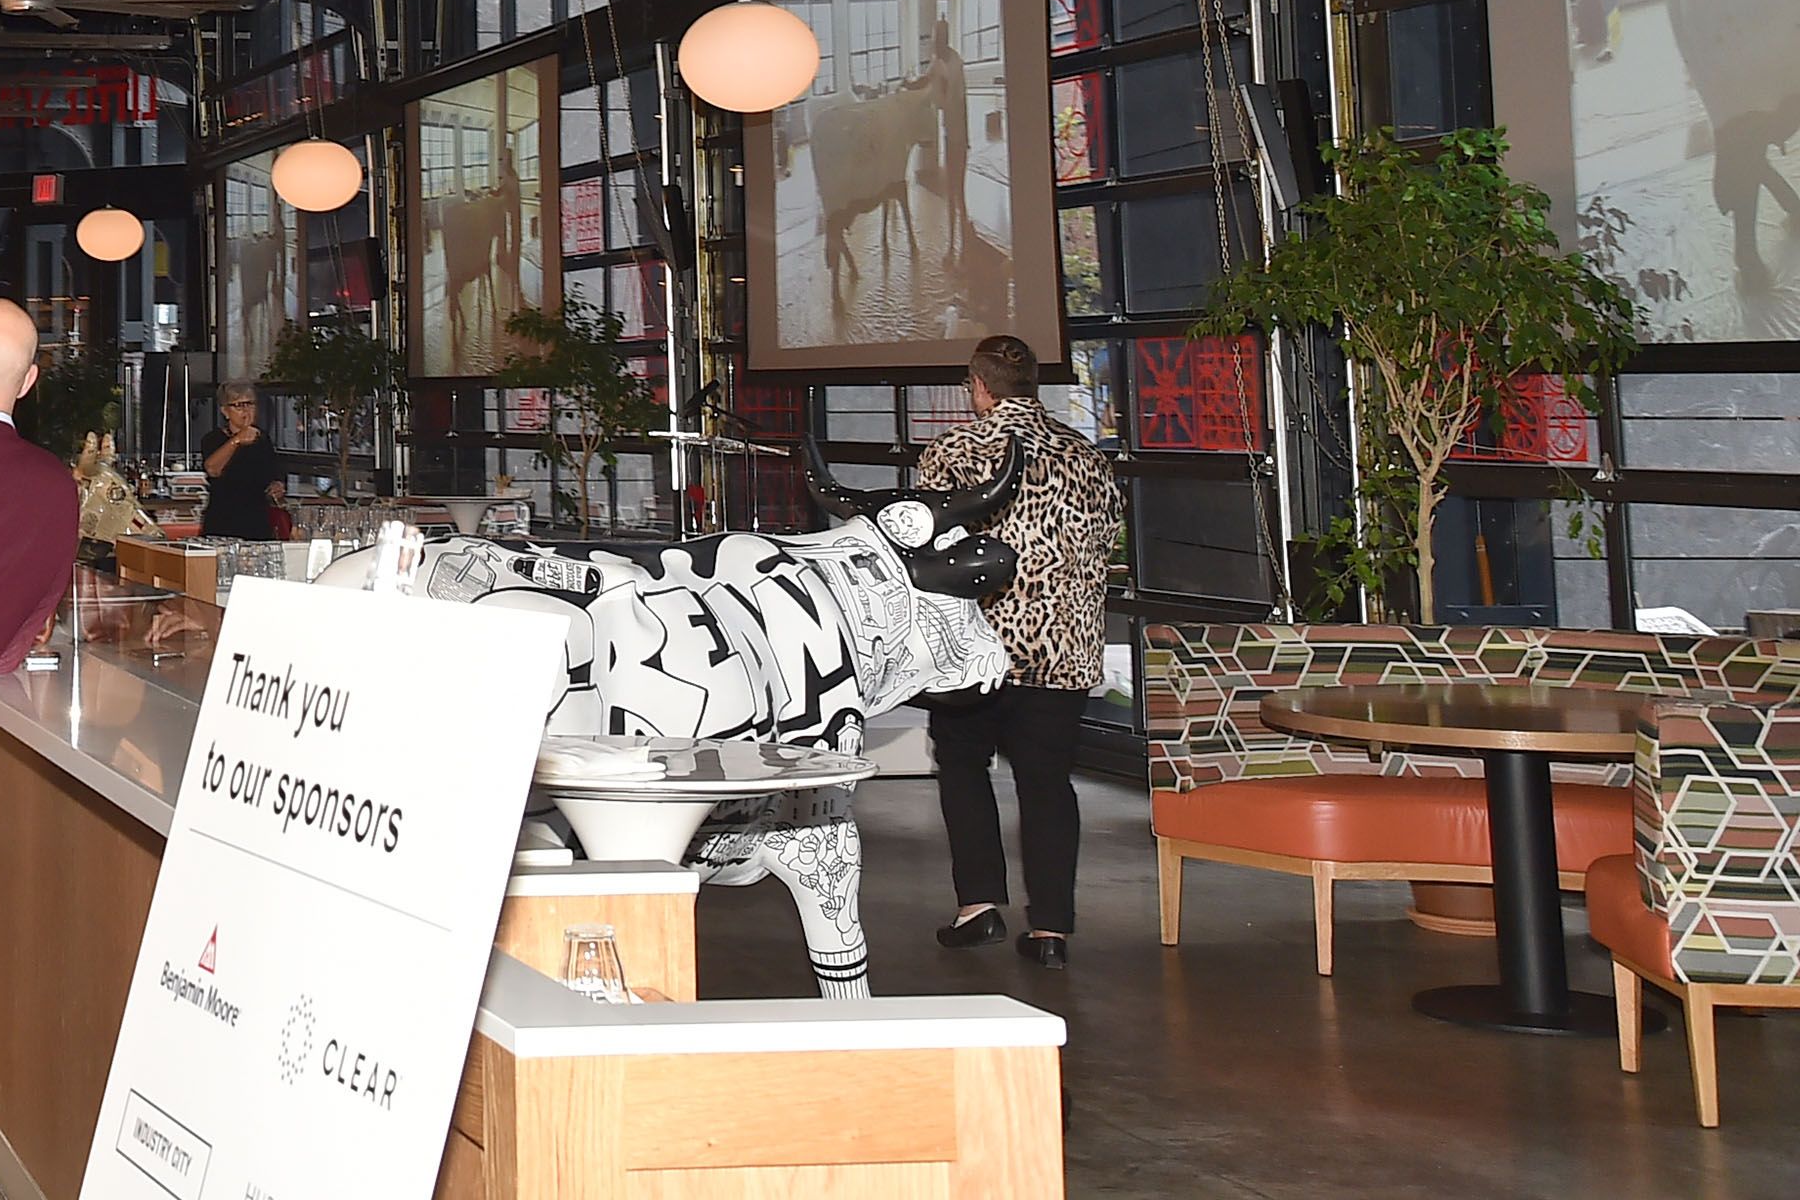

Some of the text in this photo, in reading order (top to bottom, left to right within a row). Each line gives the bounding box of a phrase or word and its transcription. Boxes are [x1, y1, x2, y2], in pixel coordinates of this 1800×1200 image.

[226, 652, 350, 739] Thank you
[202, 740, 403, 853] to our sponsors
[160, 960, 240, 1028] Benjamin Moore
[322, 1039, 398, 1111] CLEAR
[132, 1117, 193, 1177] INDUSTRY CITY
